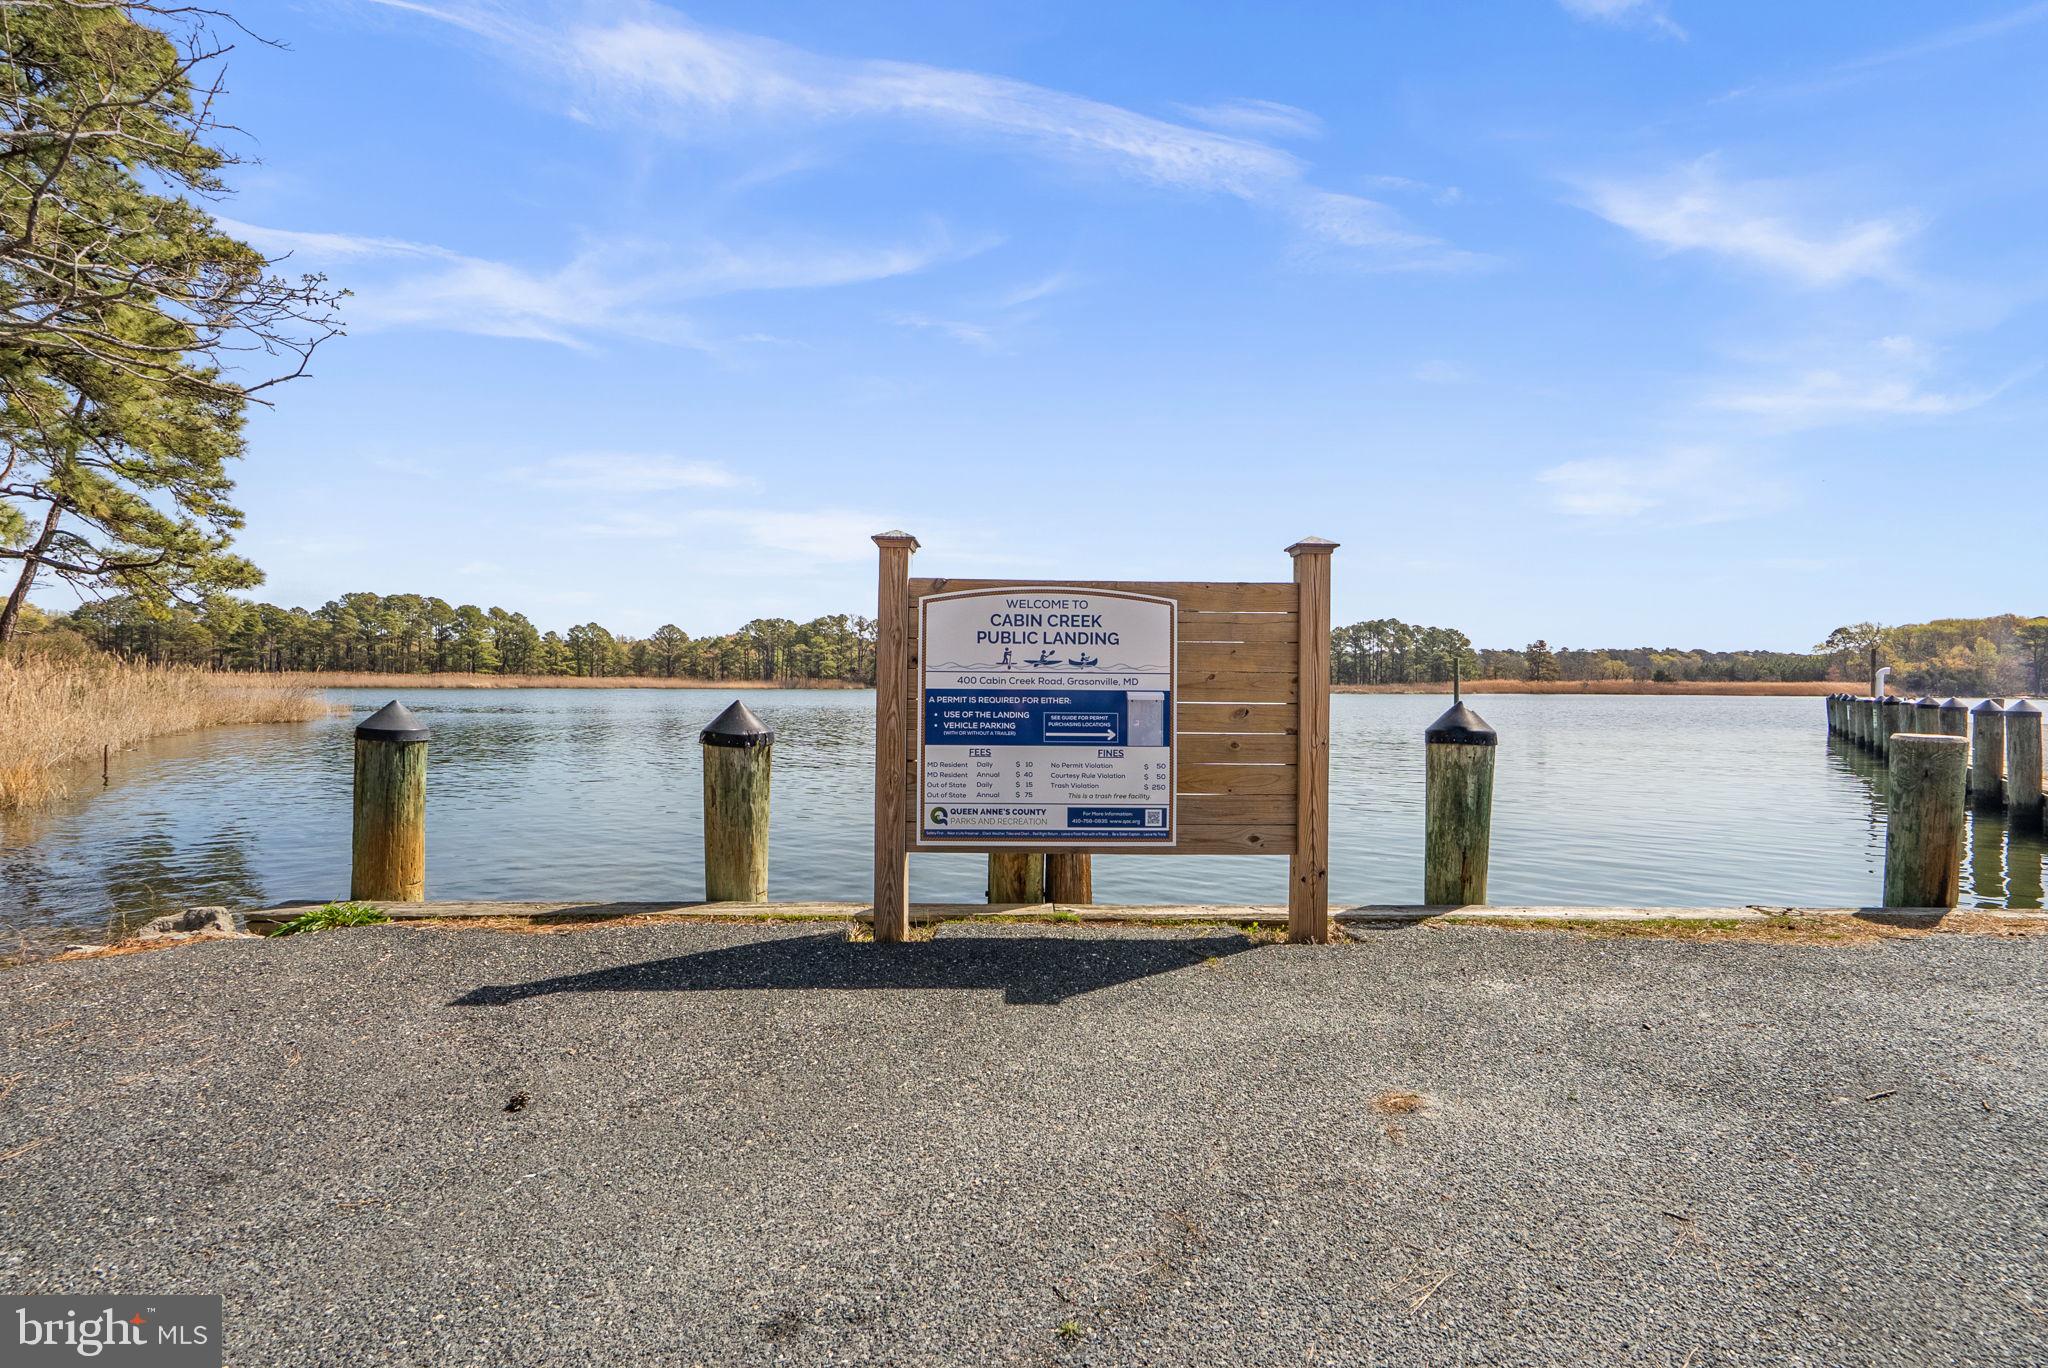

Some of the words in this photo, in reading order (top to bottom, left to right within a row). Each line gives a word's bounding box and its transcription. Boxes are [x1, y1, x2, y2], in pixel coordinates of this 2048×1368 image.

[1006, 599, 1069, 609] WELCOME
[1072, 599, 1088, 609] TO
[991, 614, 1042, 628] CABIN
[1047, 614, 1102, 628] CREEK
[977, 631, 1038, 645] PUBLIC
[1043, 631, 1119, 645] LANDING
[957, 676, 977, 685] 400
[980, 676, 1006, 685] Cabin
[1008, 676, 1035, 685] Creek
[1038, 676, 1065, 686] Road,
[1067, 676, 1120, 687] Grasonville,
[1123, 678, 1139, 686] MD
[1097, 750, 1124, 758] FINES
